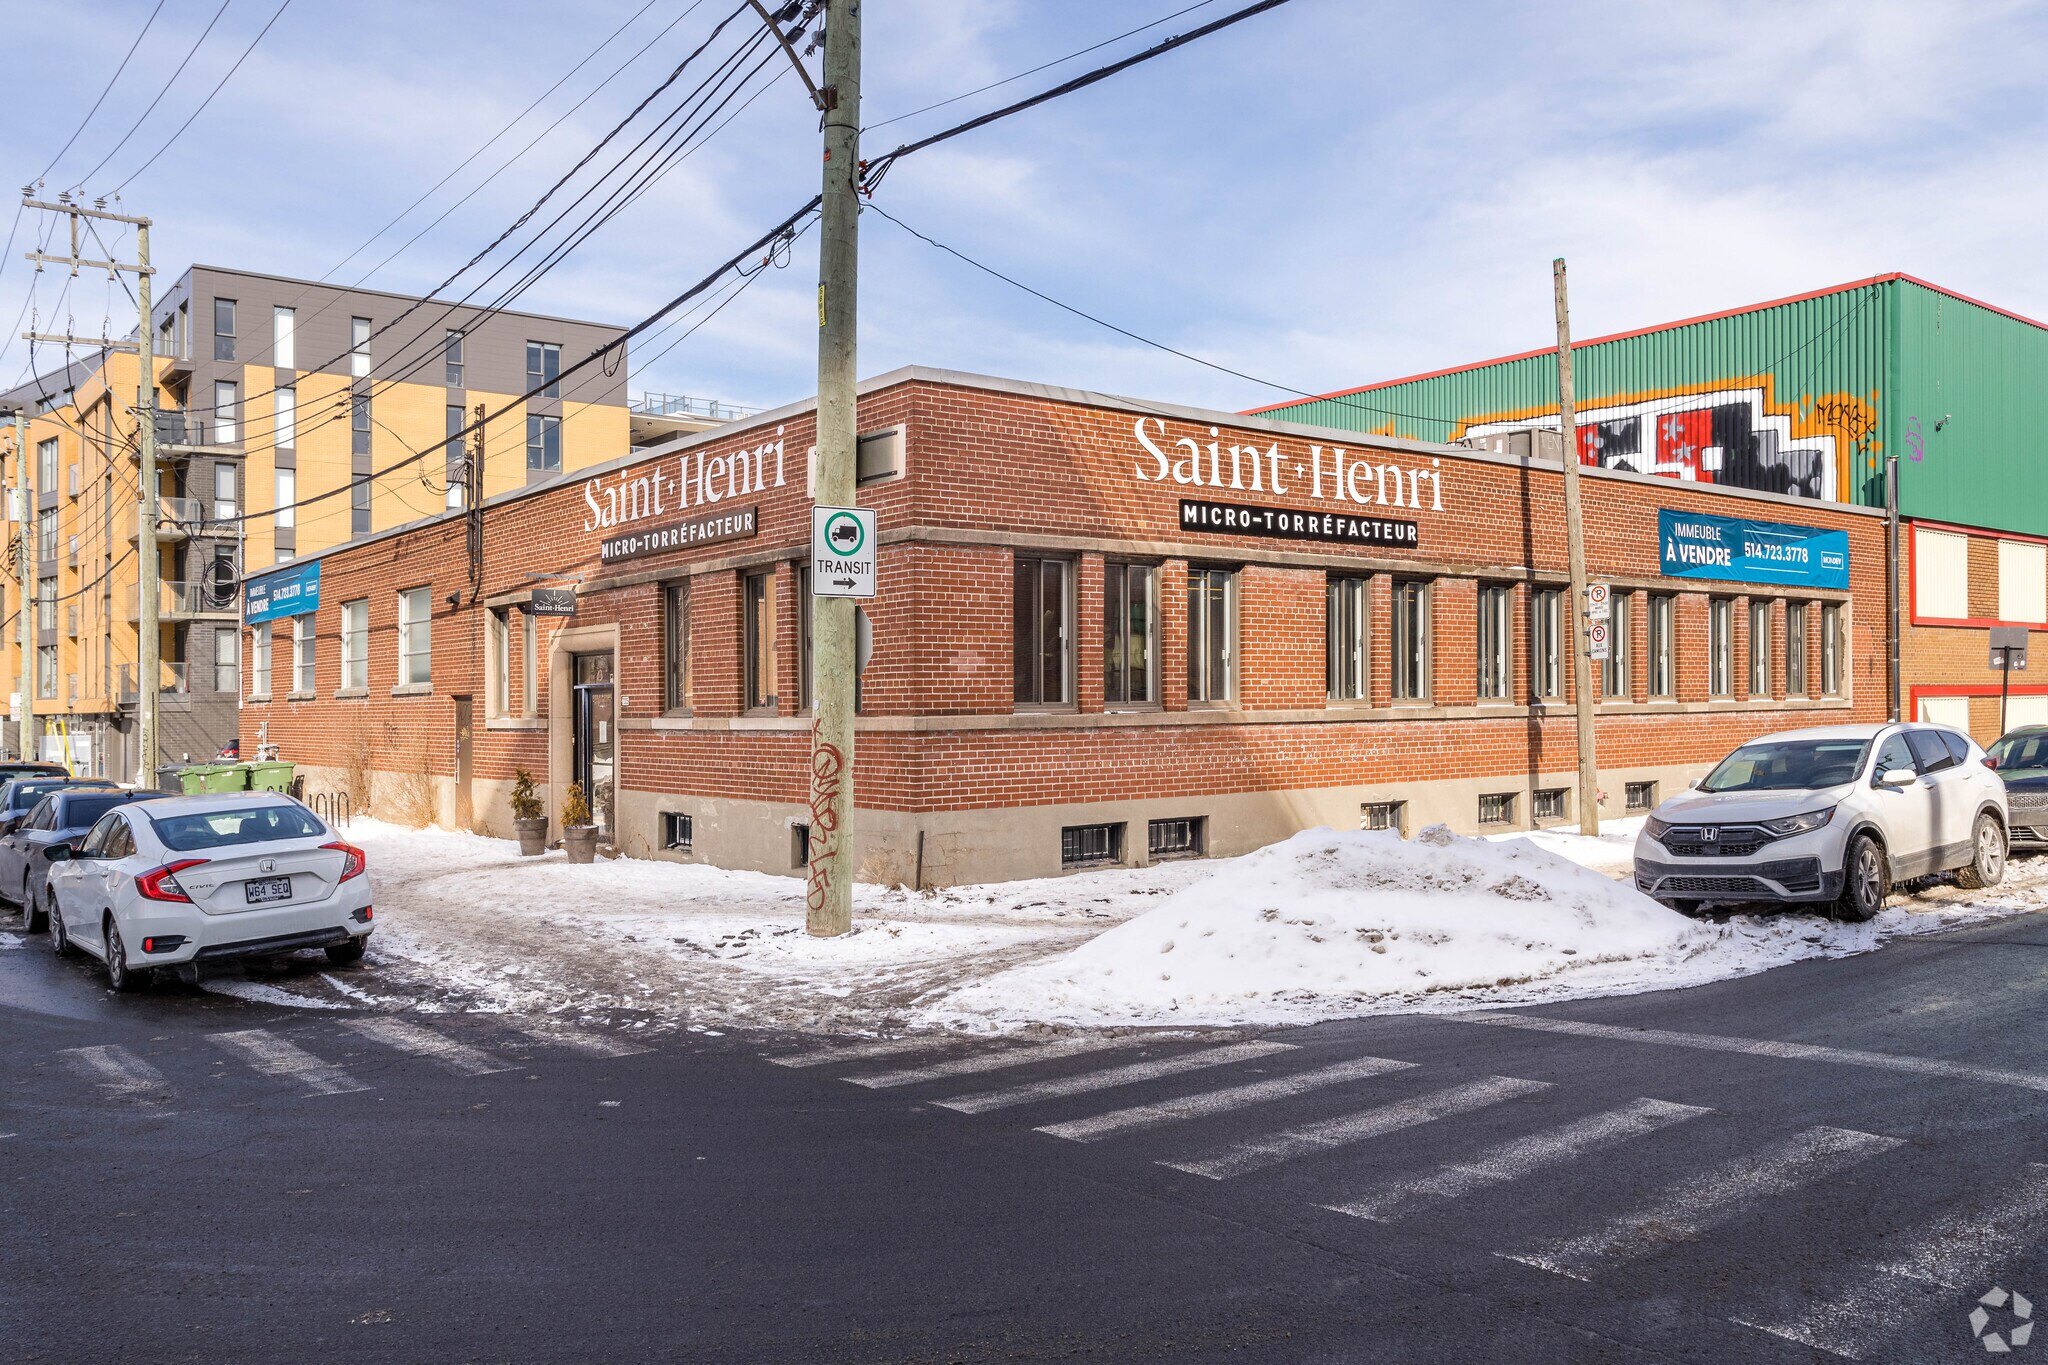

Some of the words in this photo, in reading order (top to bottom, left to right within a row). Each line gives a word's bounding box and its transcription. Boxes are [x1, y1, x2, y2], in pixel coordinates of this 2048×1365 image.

[1184, 504, 1417, 542] MICRO-TORRÉFACTEUR
[1674, 522, 1722, 541] IMMEUBLE
[601, 512, 754, 560] MICRO-TORRÉFACTEUR
[1666, 537, 1677, 562] À
[1679, 543, 1732, 567] VENDRE
[1744, 541, 1809, 564] 514.723.3778
[817, 559, 872, 575] TRANSIT
[251, 598, 269, 614] VENDRE
[271, 883, 289, 894] SEQ
